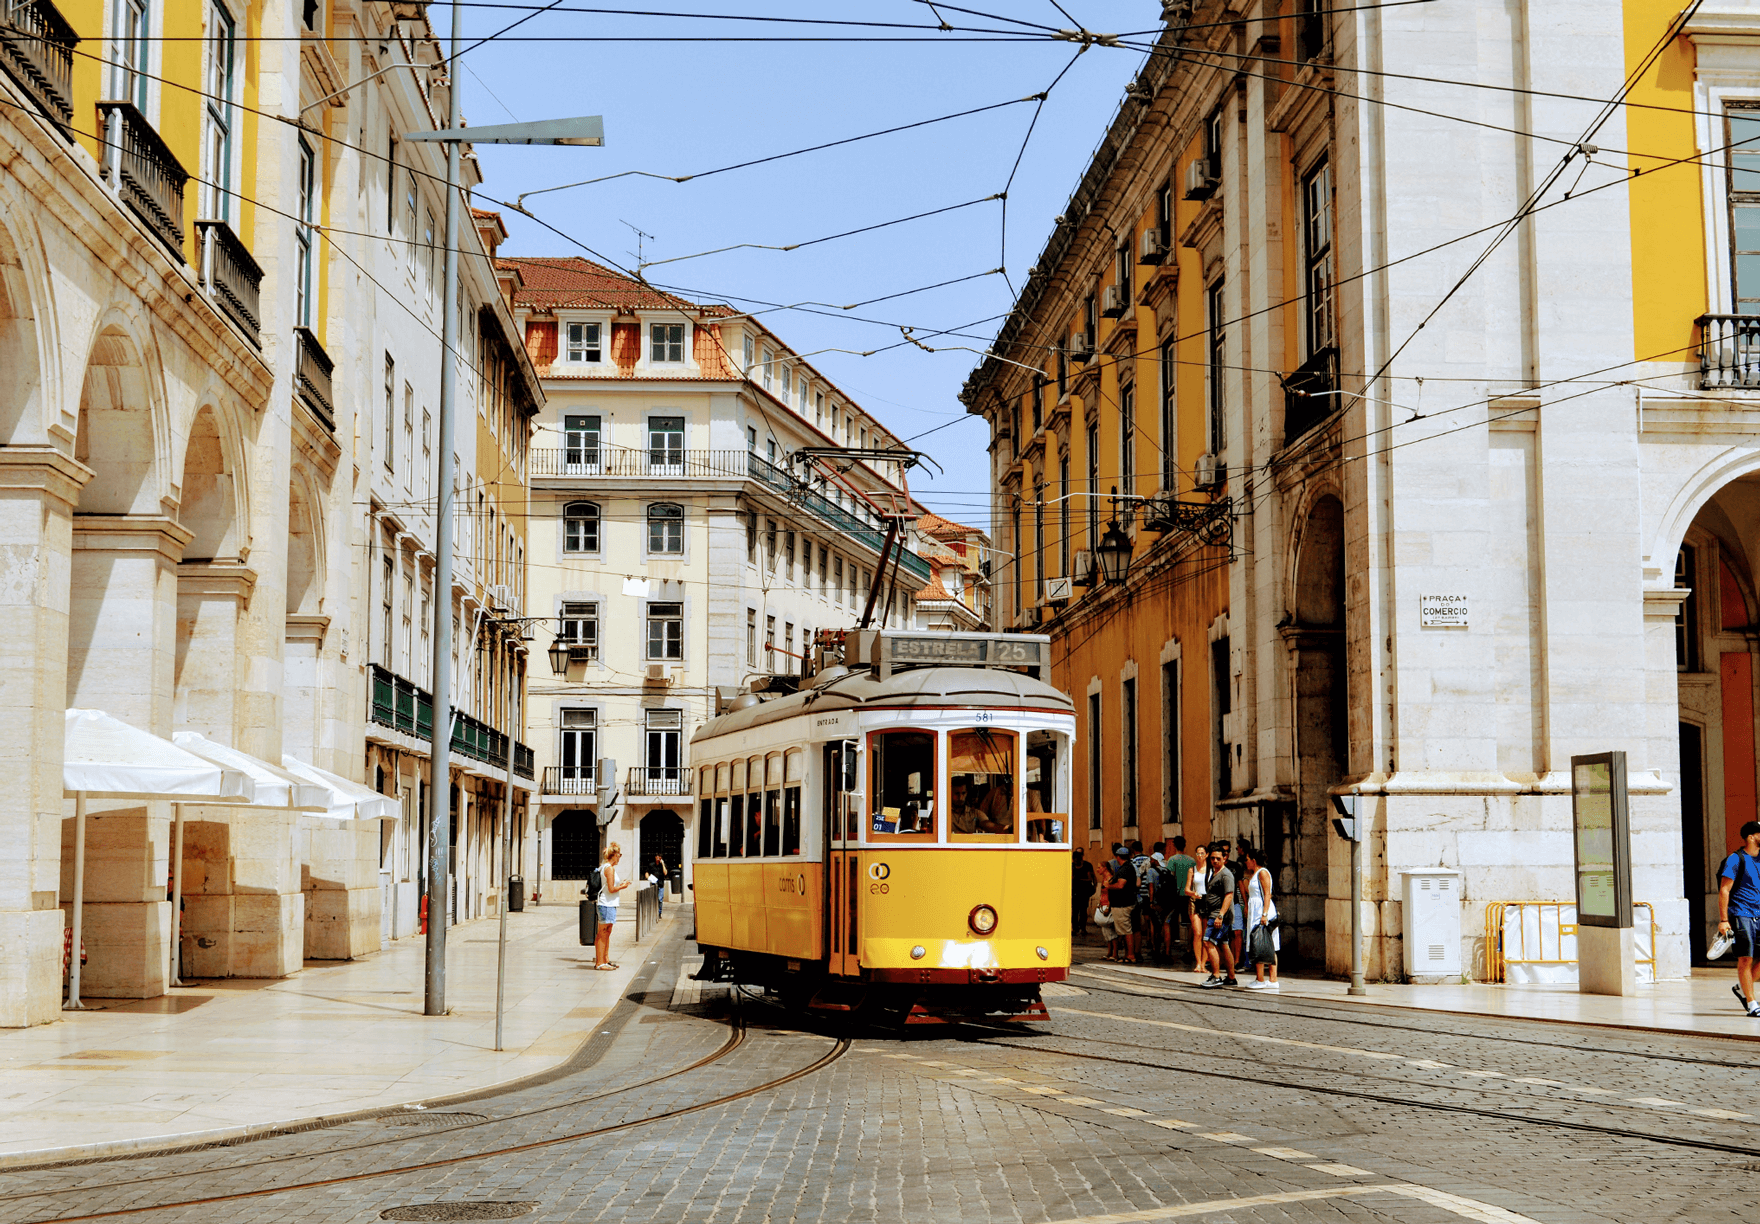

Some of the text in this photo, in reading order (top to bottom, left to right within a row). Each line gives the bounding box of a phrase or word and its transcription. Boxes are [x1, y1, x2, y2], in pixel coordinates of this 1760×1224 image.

[1429, 596, 1460, 604] PRAÇA
[897, 641, 979, 655] ESTRELA
[997, 642, 1026, 660] 25
[975, 712, 993, 723] 581
[873, 823, 882, 831] 01
